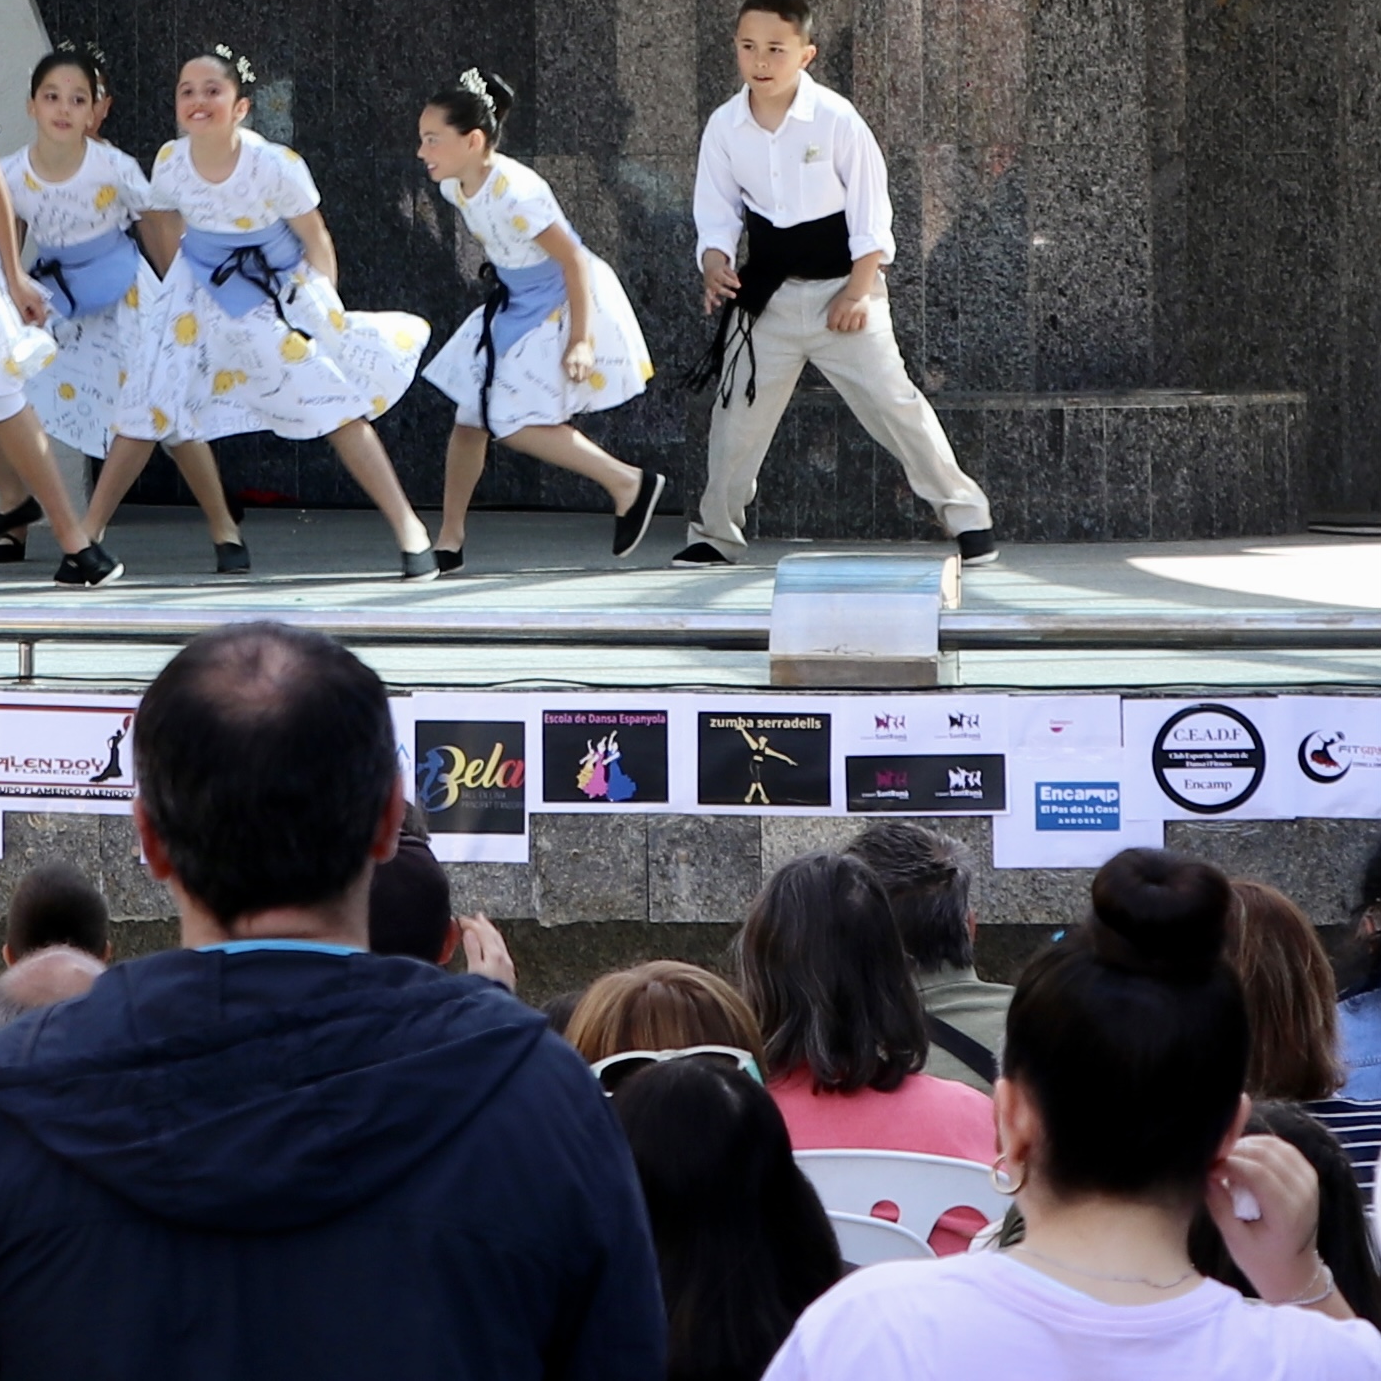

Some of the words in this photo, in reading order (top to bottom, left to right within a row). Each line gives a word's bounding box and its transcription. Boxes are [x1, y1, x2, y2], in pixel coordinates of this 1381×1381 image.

[544, 713, 572, 724] Escola
[574, 713, 586, 724] de
[588, 713, 618, 724] Dansa
[619, 713, 666, 726] Espanyola
[709, 716, 754, 729] zumba
[756, 716, 822, 730] serradells
[1173, 728, 1242, 742] C.E.A.D.F
[1184, 778, 1232, 791] Encamp
[24, 786, 82, 796] FLAMENCO
[85, 788, 135, 798] ALENDOY
[1040, 785, 1118, 803] Encamp
[1040, 805, 1050, 814] El
[1051, 805, 1068, 814] Pas
[1069, 805, 1083, 814] de
[1084, 805, 1094, 814] la
[1095, 805, 1118, 814] Casa
